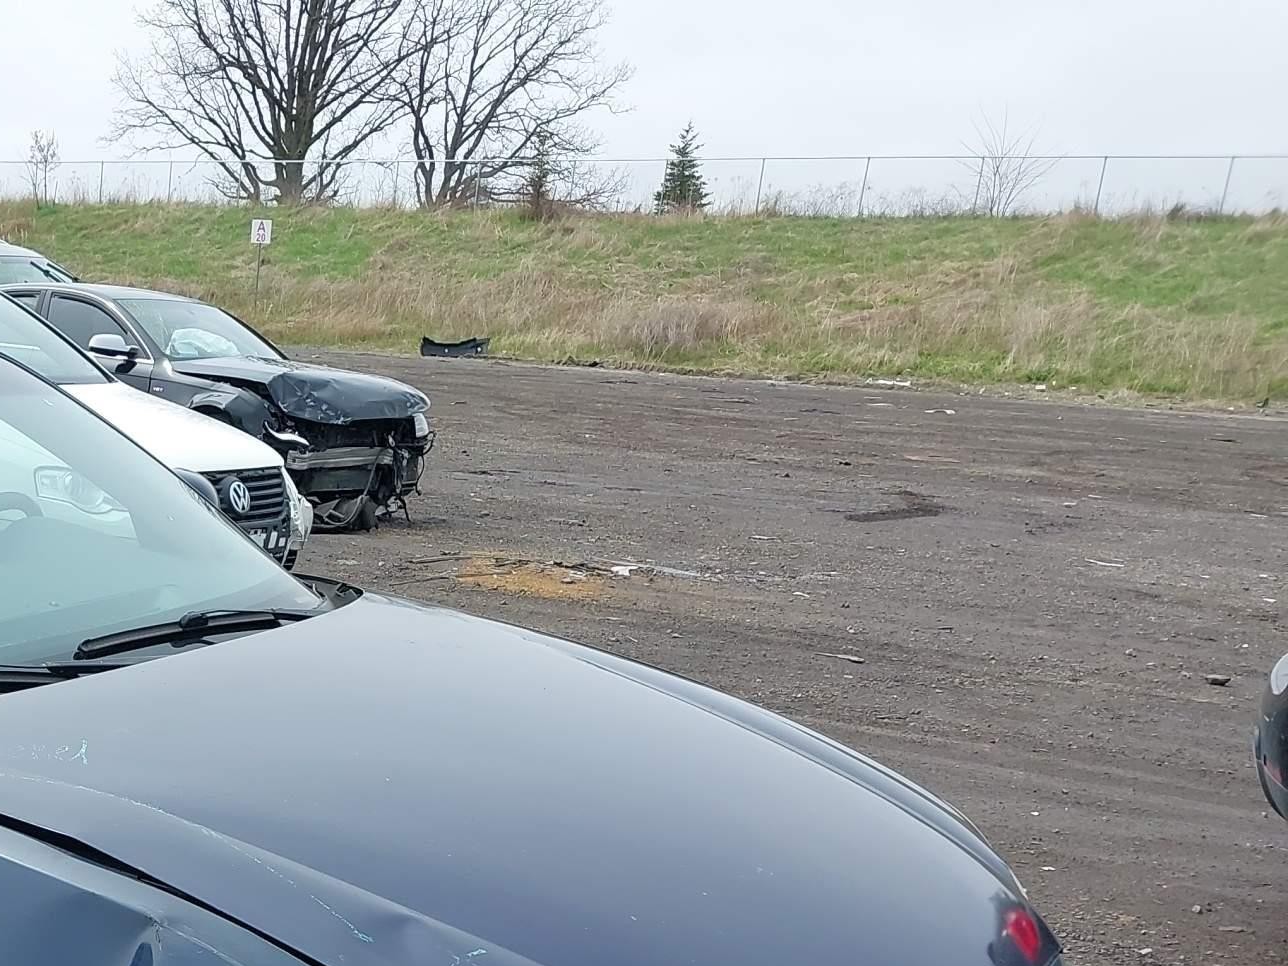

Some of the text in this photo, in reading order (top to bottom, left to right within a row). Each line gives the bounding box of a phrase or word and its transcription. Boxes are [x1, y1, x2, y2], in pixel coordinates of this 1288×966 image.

[257, 220, 266, 233] A
[256, 232, 266, 242] 20
[229, 481, 250, 513] VW
